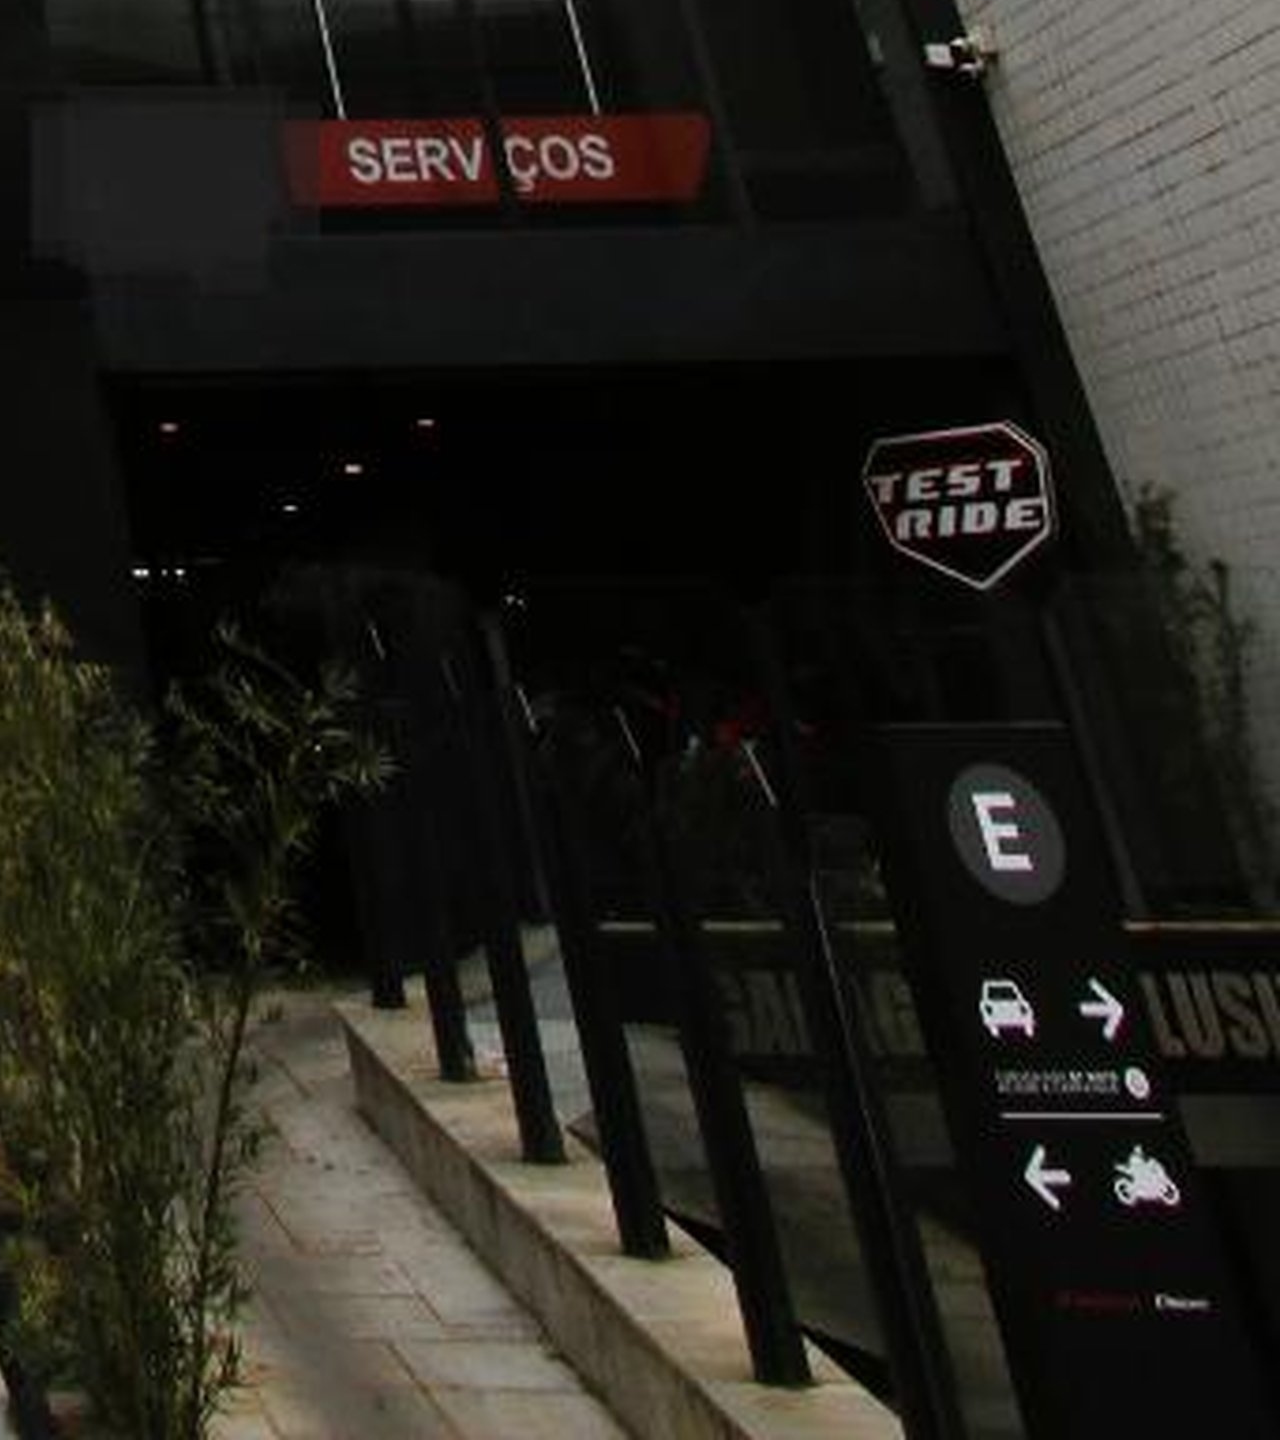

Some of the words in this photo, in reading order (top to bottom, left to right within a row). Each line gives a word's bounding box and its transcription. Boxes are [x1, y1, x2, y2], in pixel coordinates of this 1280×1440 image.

[347, 134, 616, 192] SERVÇOS
[867, 458, 1024, 504] TEST
[895, 496, 1041, 541] RIDE
[971, 792, 1034, 871] E
